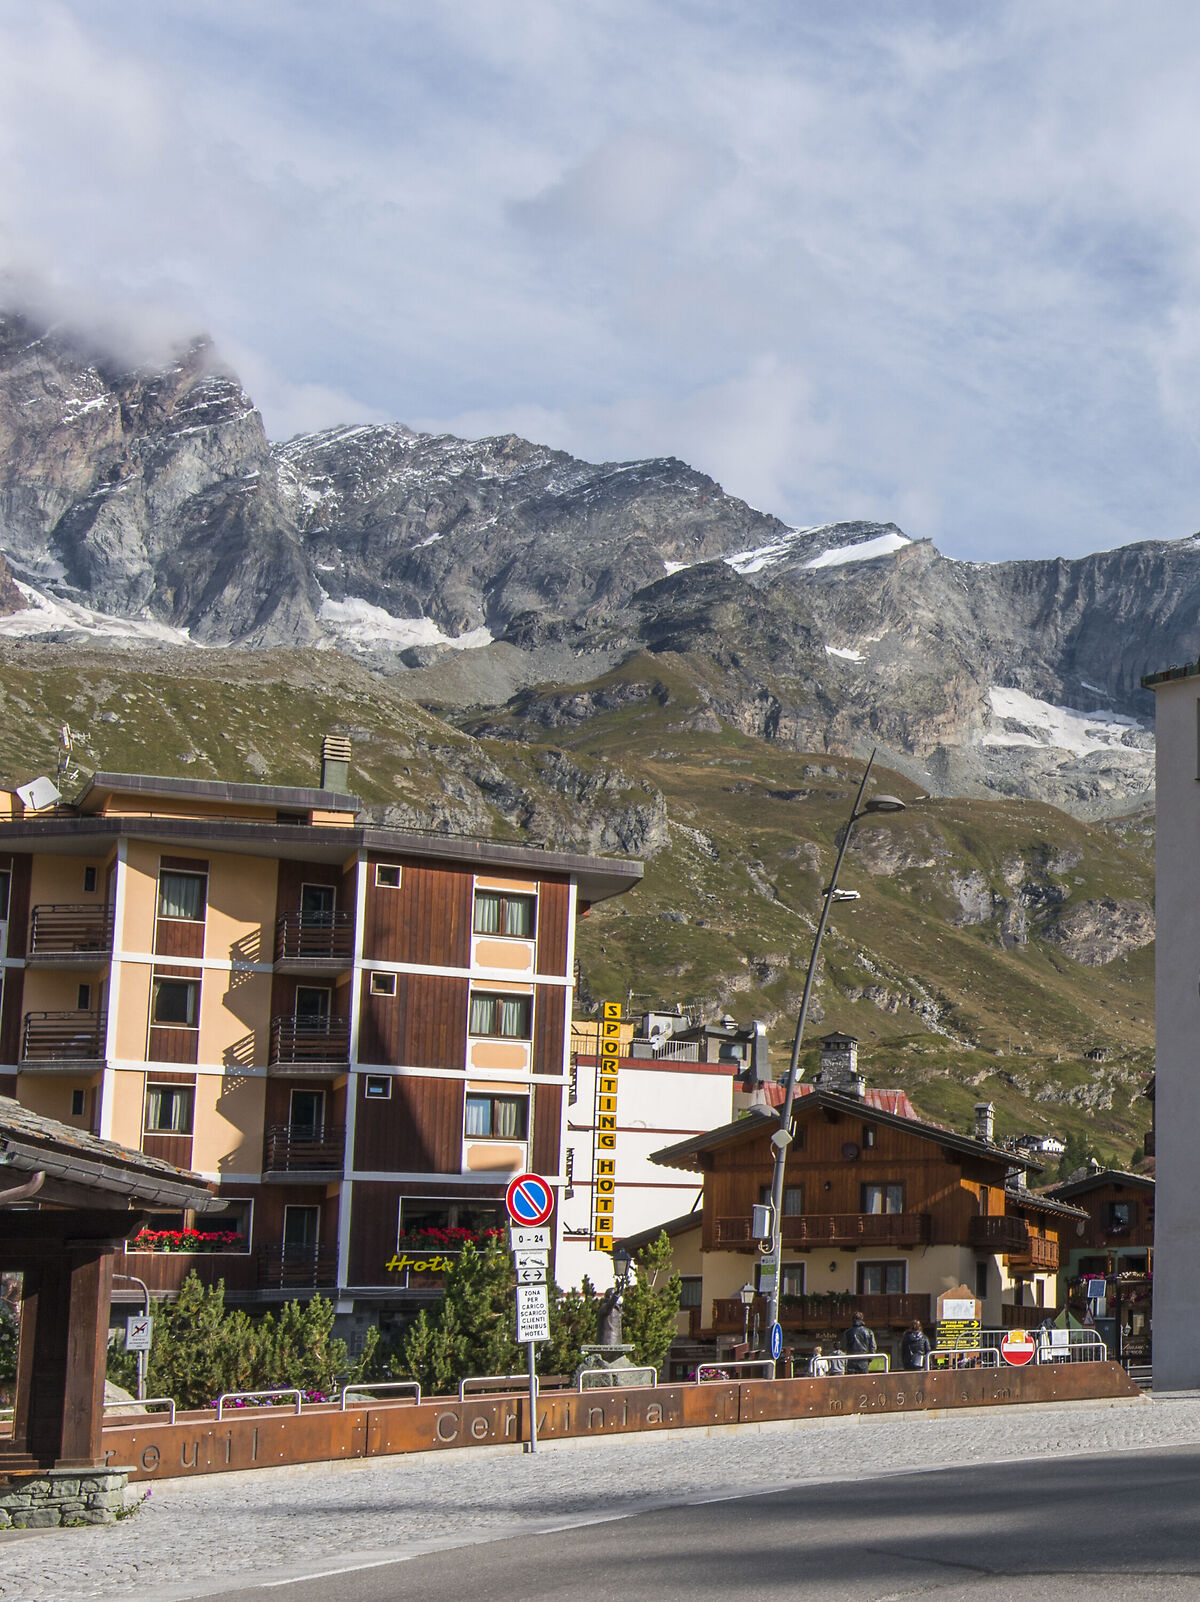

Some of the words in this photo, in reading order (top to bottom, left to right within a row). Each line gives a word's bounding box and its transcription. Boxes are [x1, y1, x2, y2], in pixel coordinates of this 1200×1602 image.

[600, 1003, 619, 1148] SPORTING
[598, 1160, 614, 1249] HOTEL
[535, 1235, 543, 1243] 24
[103, 1427, 258, 1472] reuil
